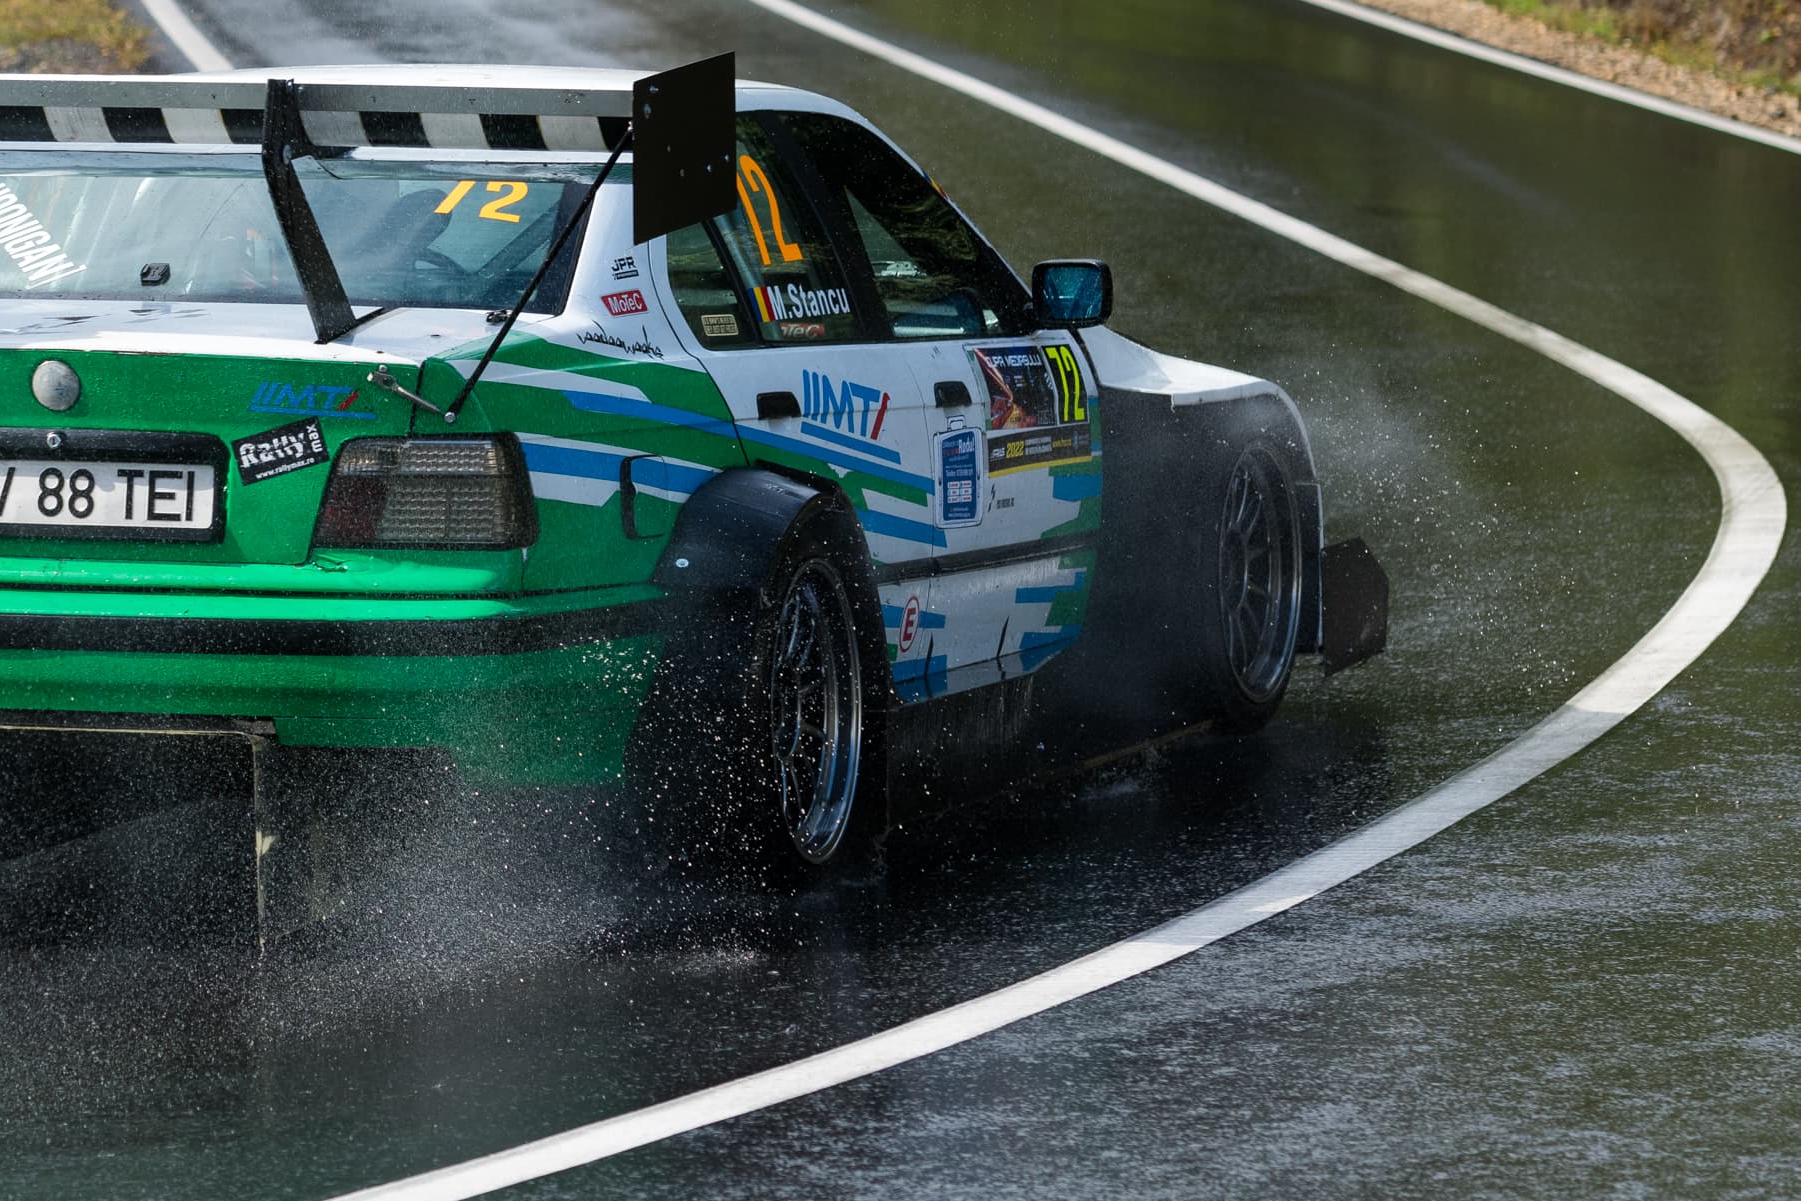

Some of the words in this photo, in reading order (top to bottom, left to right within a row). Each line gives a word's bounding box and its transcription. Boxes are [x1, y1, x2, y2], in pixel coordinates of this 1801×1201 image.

[607, 292, 643, 314] MoTeC
[766, 283, 851, 321] M.Stancu
[1045, 346, 1085, 422] 72
[239, 432, 306, 468] Rally
[306, 423, 323, 453] max
[1006, 441, 1025, 459] 2022
[255, 457, 315, 479] www.rallymax.ro
[37, 466, 96, 520] 88
[117, 468, 196, 522] TEI
[902, 607, 917, 642] E
